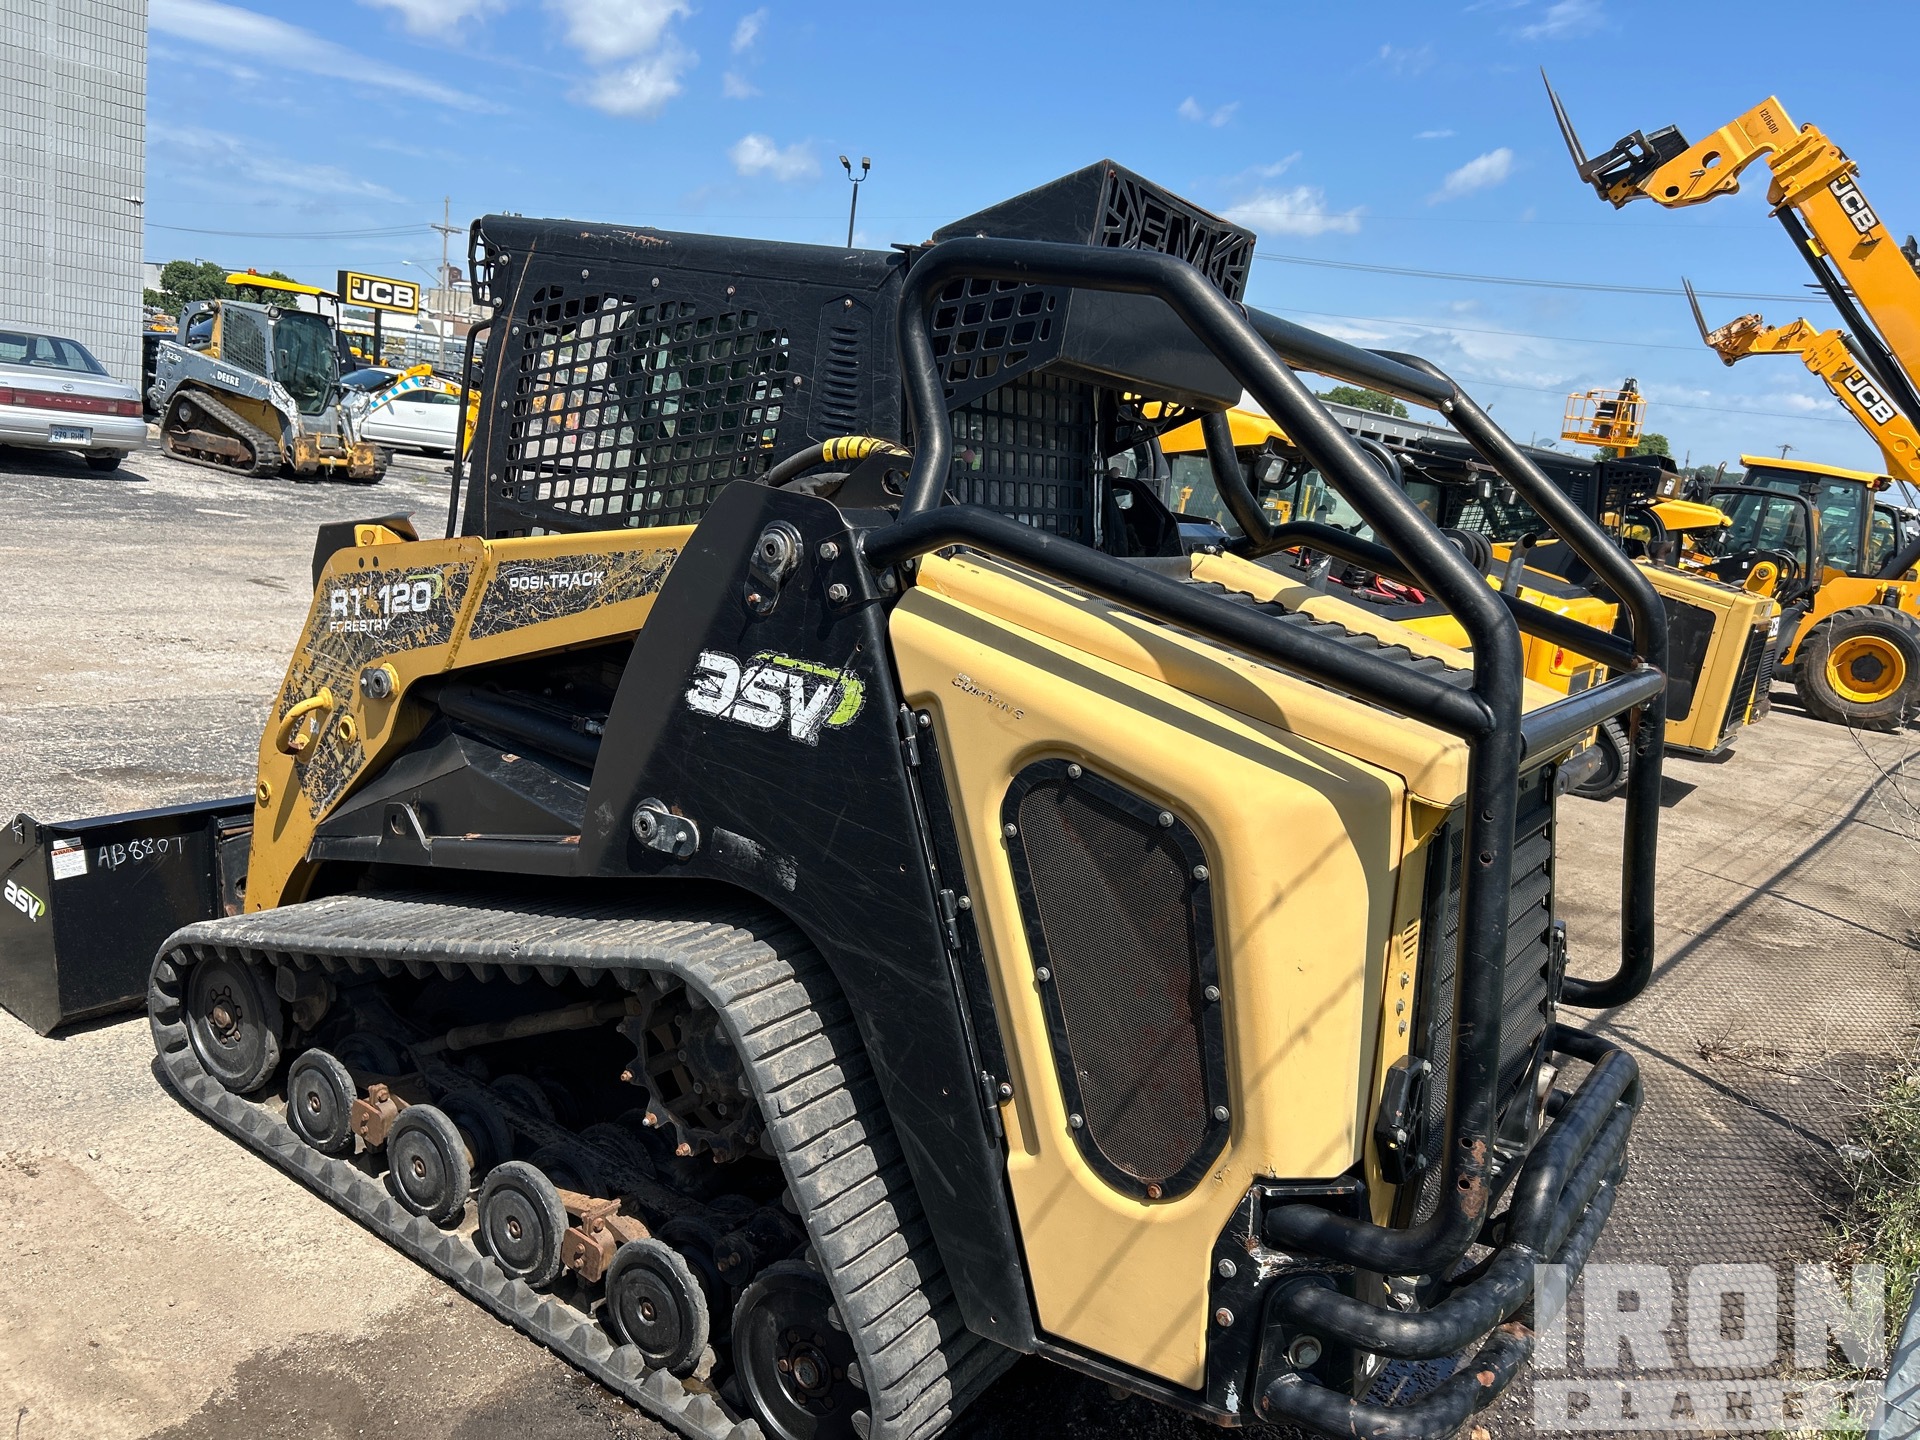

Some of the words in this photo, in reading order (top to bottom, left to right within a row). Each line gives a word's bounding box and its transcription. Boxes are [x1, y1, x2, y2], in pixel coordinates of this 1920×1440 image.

[1759, 108, 1779, 134] 120600
[1829, 174, 1877, 233] JCB
[351, 278, 416, 308] JCB
[216, 370, 240, 388] DEERE
[419, 378, 441, 389] JCB
[45, 397, 92, 405] CAMRY
[1844, 371, 1895, 424] JCB
[509, 571, 604, 590] POSI-TRACK
[378, 581, 431, 614] 120
[330, 618, 390, 632] FORESTRY
